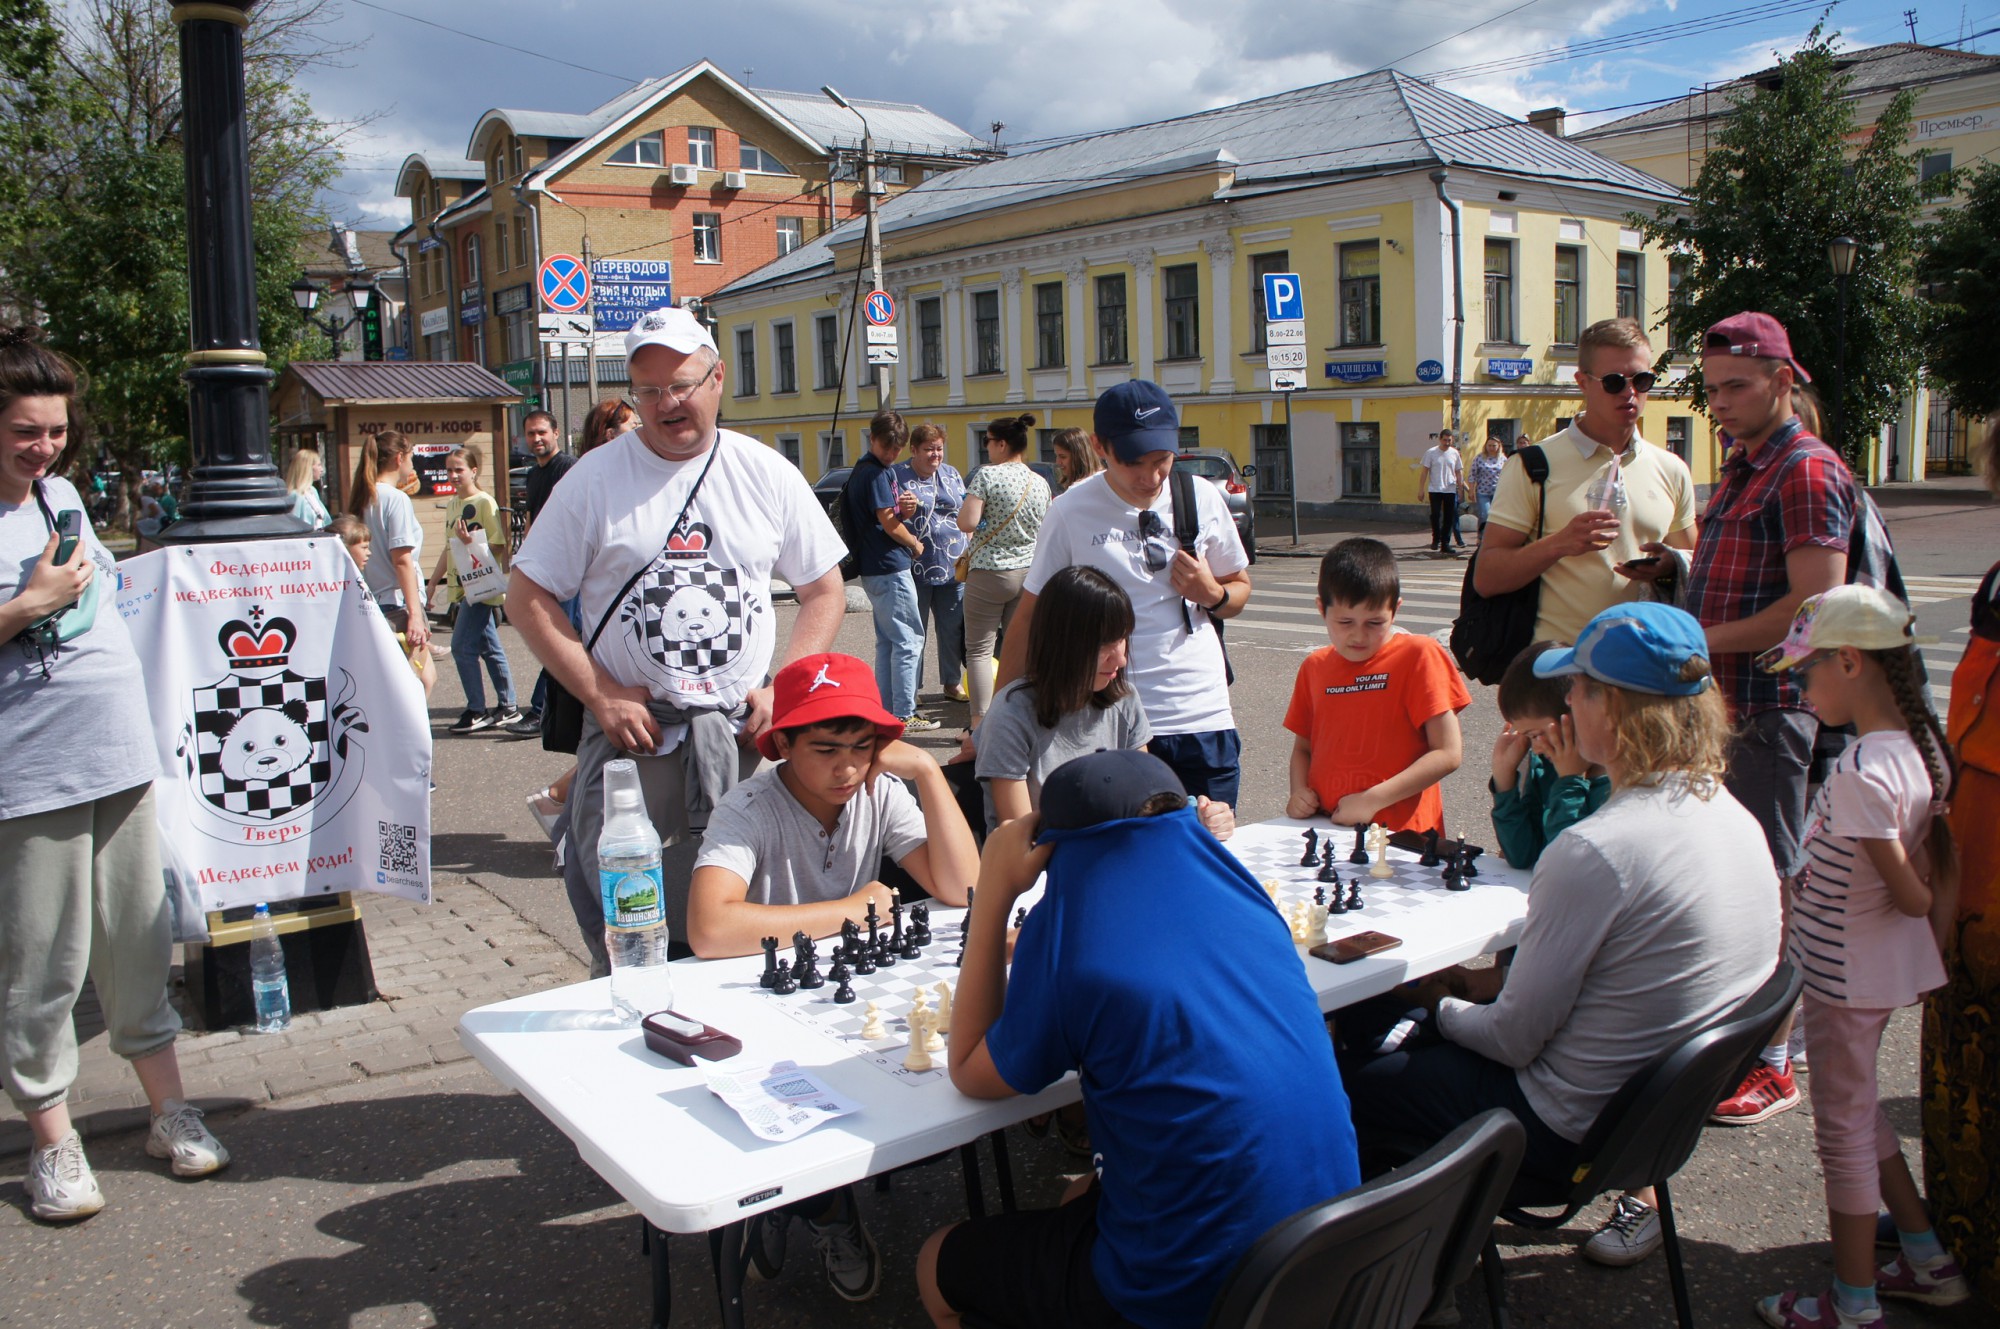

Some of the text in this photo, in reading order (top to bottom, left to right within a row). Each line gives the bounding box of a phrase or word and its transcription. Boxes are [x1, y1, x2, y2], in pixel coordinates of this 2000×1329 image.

[1919, 114, 1983, 137] Премьер
[593, 262, 667, 276] ПЕРЕВОДОВ
[632, 285, 667, 298] ОТДЫХ
[1269, 329, 1304, 338] 8.00-22.00
[1271, 351, 1303, 362] 10 15 20
[506, 368, 531, 382] ОПТИКА
[1331, 364, 1378, 375] РАДИЩЕВА
[1417, 366, 1442, 377] 38/26
[358, 420, 483, 435] ХОТ ДОГИ КОФЕ
[209, 559, 312, 577] Федерация
[174, 579, 350, 604] медвежьих шахмат
[1345, 684, 1364, 692] ONLY
[1364, 682, 1386, 690] LIMIT
[241, 824, 303, 843] Тверь
[197, 846, 354, 886] Медведем ходи!
[385, 873, 424, 889] bearchess
[743, 1188, 778, 1206] LIFETIME
